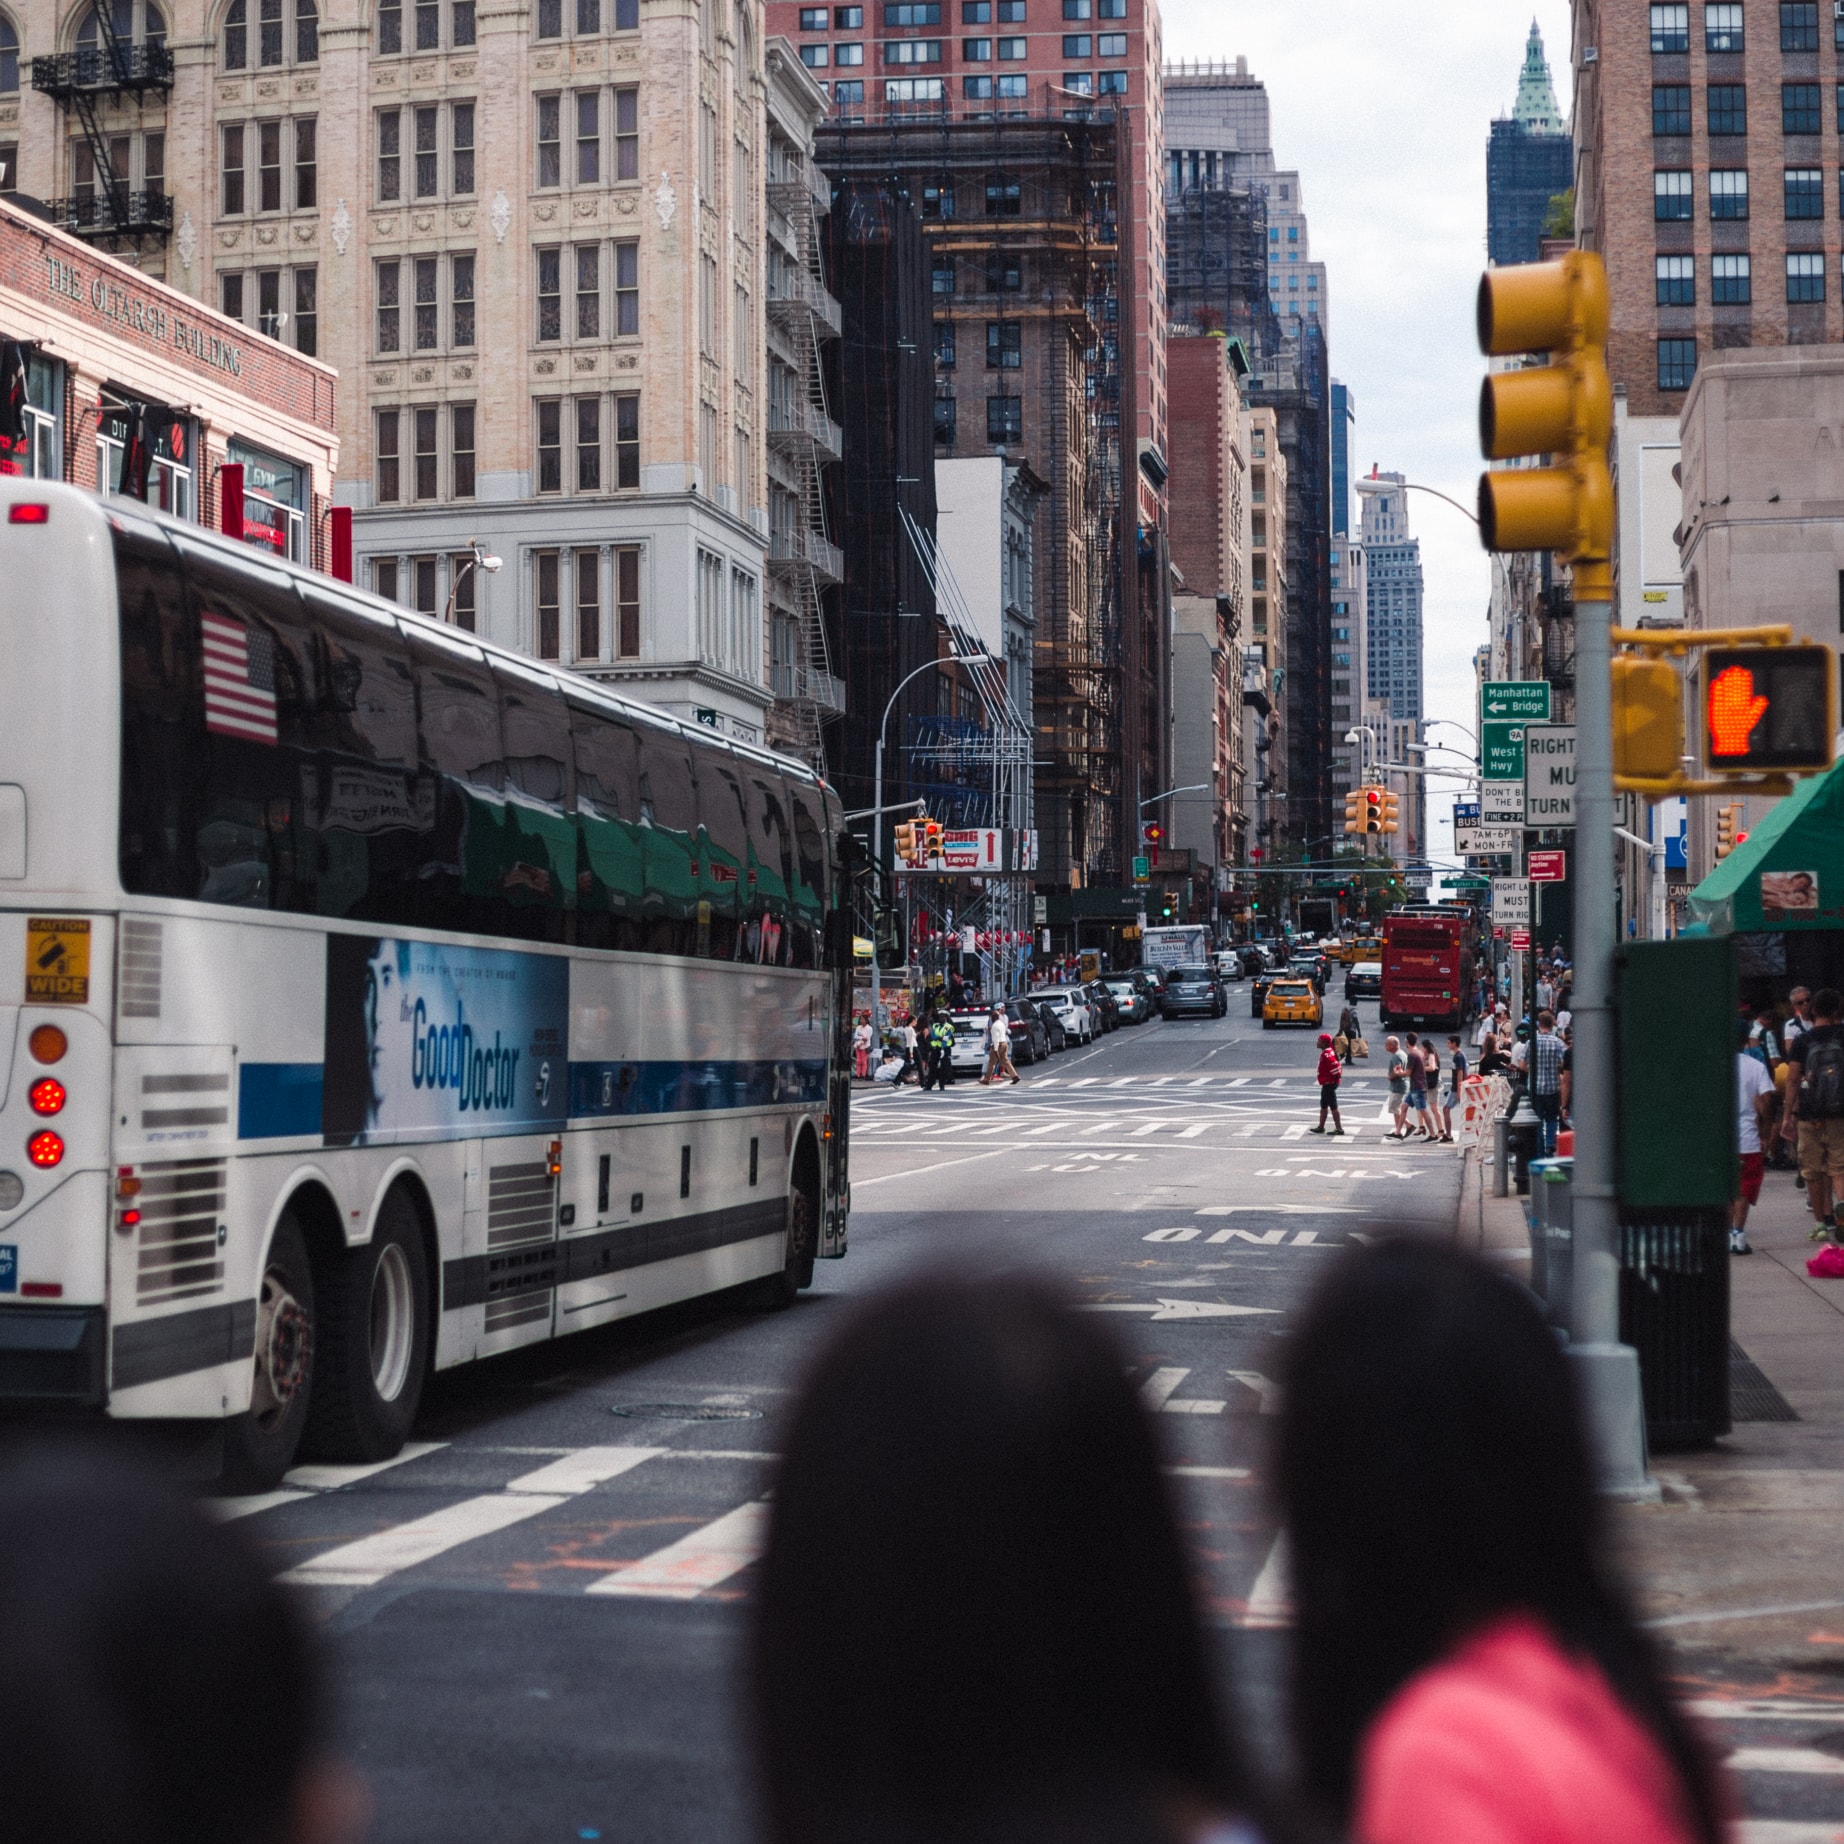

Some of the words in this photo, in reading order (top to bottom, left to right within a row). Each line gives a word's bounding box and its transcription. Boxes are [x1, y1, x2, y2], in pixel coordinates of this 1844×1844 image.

[46, 255, 83, 301] THE
[92, 278, 168, 341] OLTARSH
[174, 317, 242, 377] BUILDING
[1488, 688, 1543, 698] Manhattan
[1512, 701, 1543, 713] Bridge
[1510, 731, 1522, 740] 9A
[1530, 738, 1576, 754] RIGHT
[1490, 747, 1517, 757] West
[1490, 761, 1513, 773] Hwy
[1550, 766, 1577, 785] MU
[1485, 788, 1511, 796] DON'T
[1495, 798, 1512, 806] THE
[1529, 798, 1570, 814] TURN
[1469, 805, 1480, 814] BU
[1458, 817, 1480, 827] BUSE
[1486, 813, 1501, 821] FINE
[1510, 813, 1515, 821] 2
[1472, 829, 1510, 839] 7AM-6P
[1474, 840, 1512, 850] MON-FR
[1494, 883, 1516, 891] RIGHT
[1518, 883, 1529, 891] LA
[1503, 897, 1529, 906] MUST
[1494, 911, 1514, 919] TURN
[1516, 911, 1529, 919] RIG
[31, 920, 87, 932] CAUTION
[30, 977, 84, 993] WIDE
[412, 997, 463, 1089] Good
[459, 1023, 520, 1111] Doctor
[1253, 1168, 1428, 1179] ONLY
[0, 1248, 13, 1260] AL
